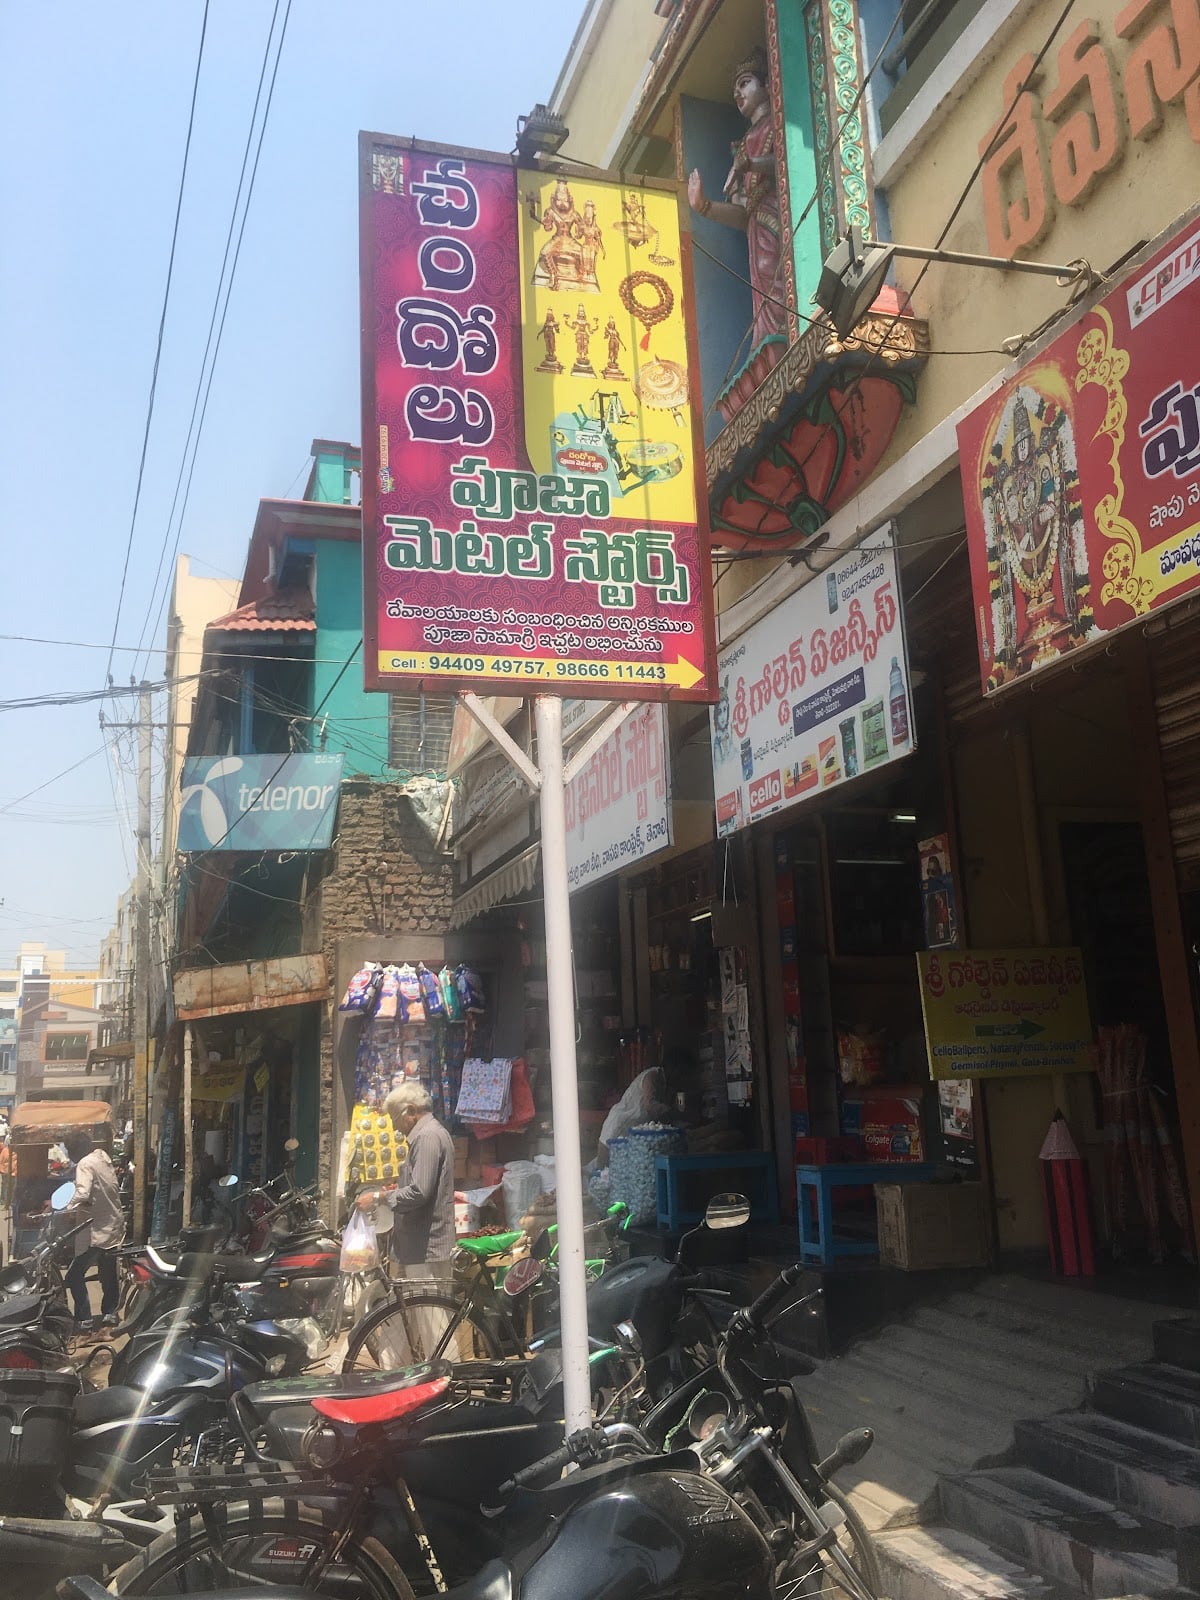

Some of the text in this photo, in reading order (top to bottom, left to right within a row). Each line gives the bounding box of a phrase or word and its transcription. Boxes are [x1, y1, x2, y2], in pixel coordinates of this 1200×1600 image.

[397, 159, 497, 447] చందోలు
[451, 456, 611, 521] పూజా
[384, 516, 691, 609] మెటల్ స్టోర్స్
[387, 599, 694, 635] దేవాలయాలకు సంబంధించిన అన్నిరకముల
[424, 625, 662, 654] పూజా సామాగ్రి ఇచ్చట లభించును
[391, 658, 417, 669] Cell
[429, 656, 485, 672] 94409
[491, 659, 550, 677] 49757,
[556, 662, 609, 677] 98666
[615, 664, 666, 679] 11443
[733, 675, 749, 738] శ్రీ
[238, 779, 334, 812] telenor
[750, 777, 780, 807] cello
[925, 954, 945, 997] శ్రీ
[865, 1134, 890, 1146] Colgate
[269, 1549, 296, 1558] SUZUKI
